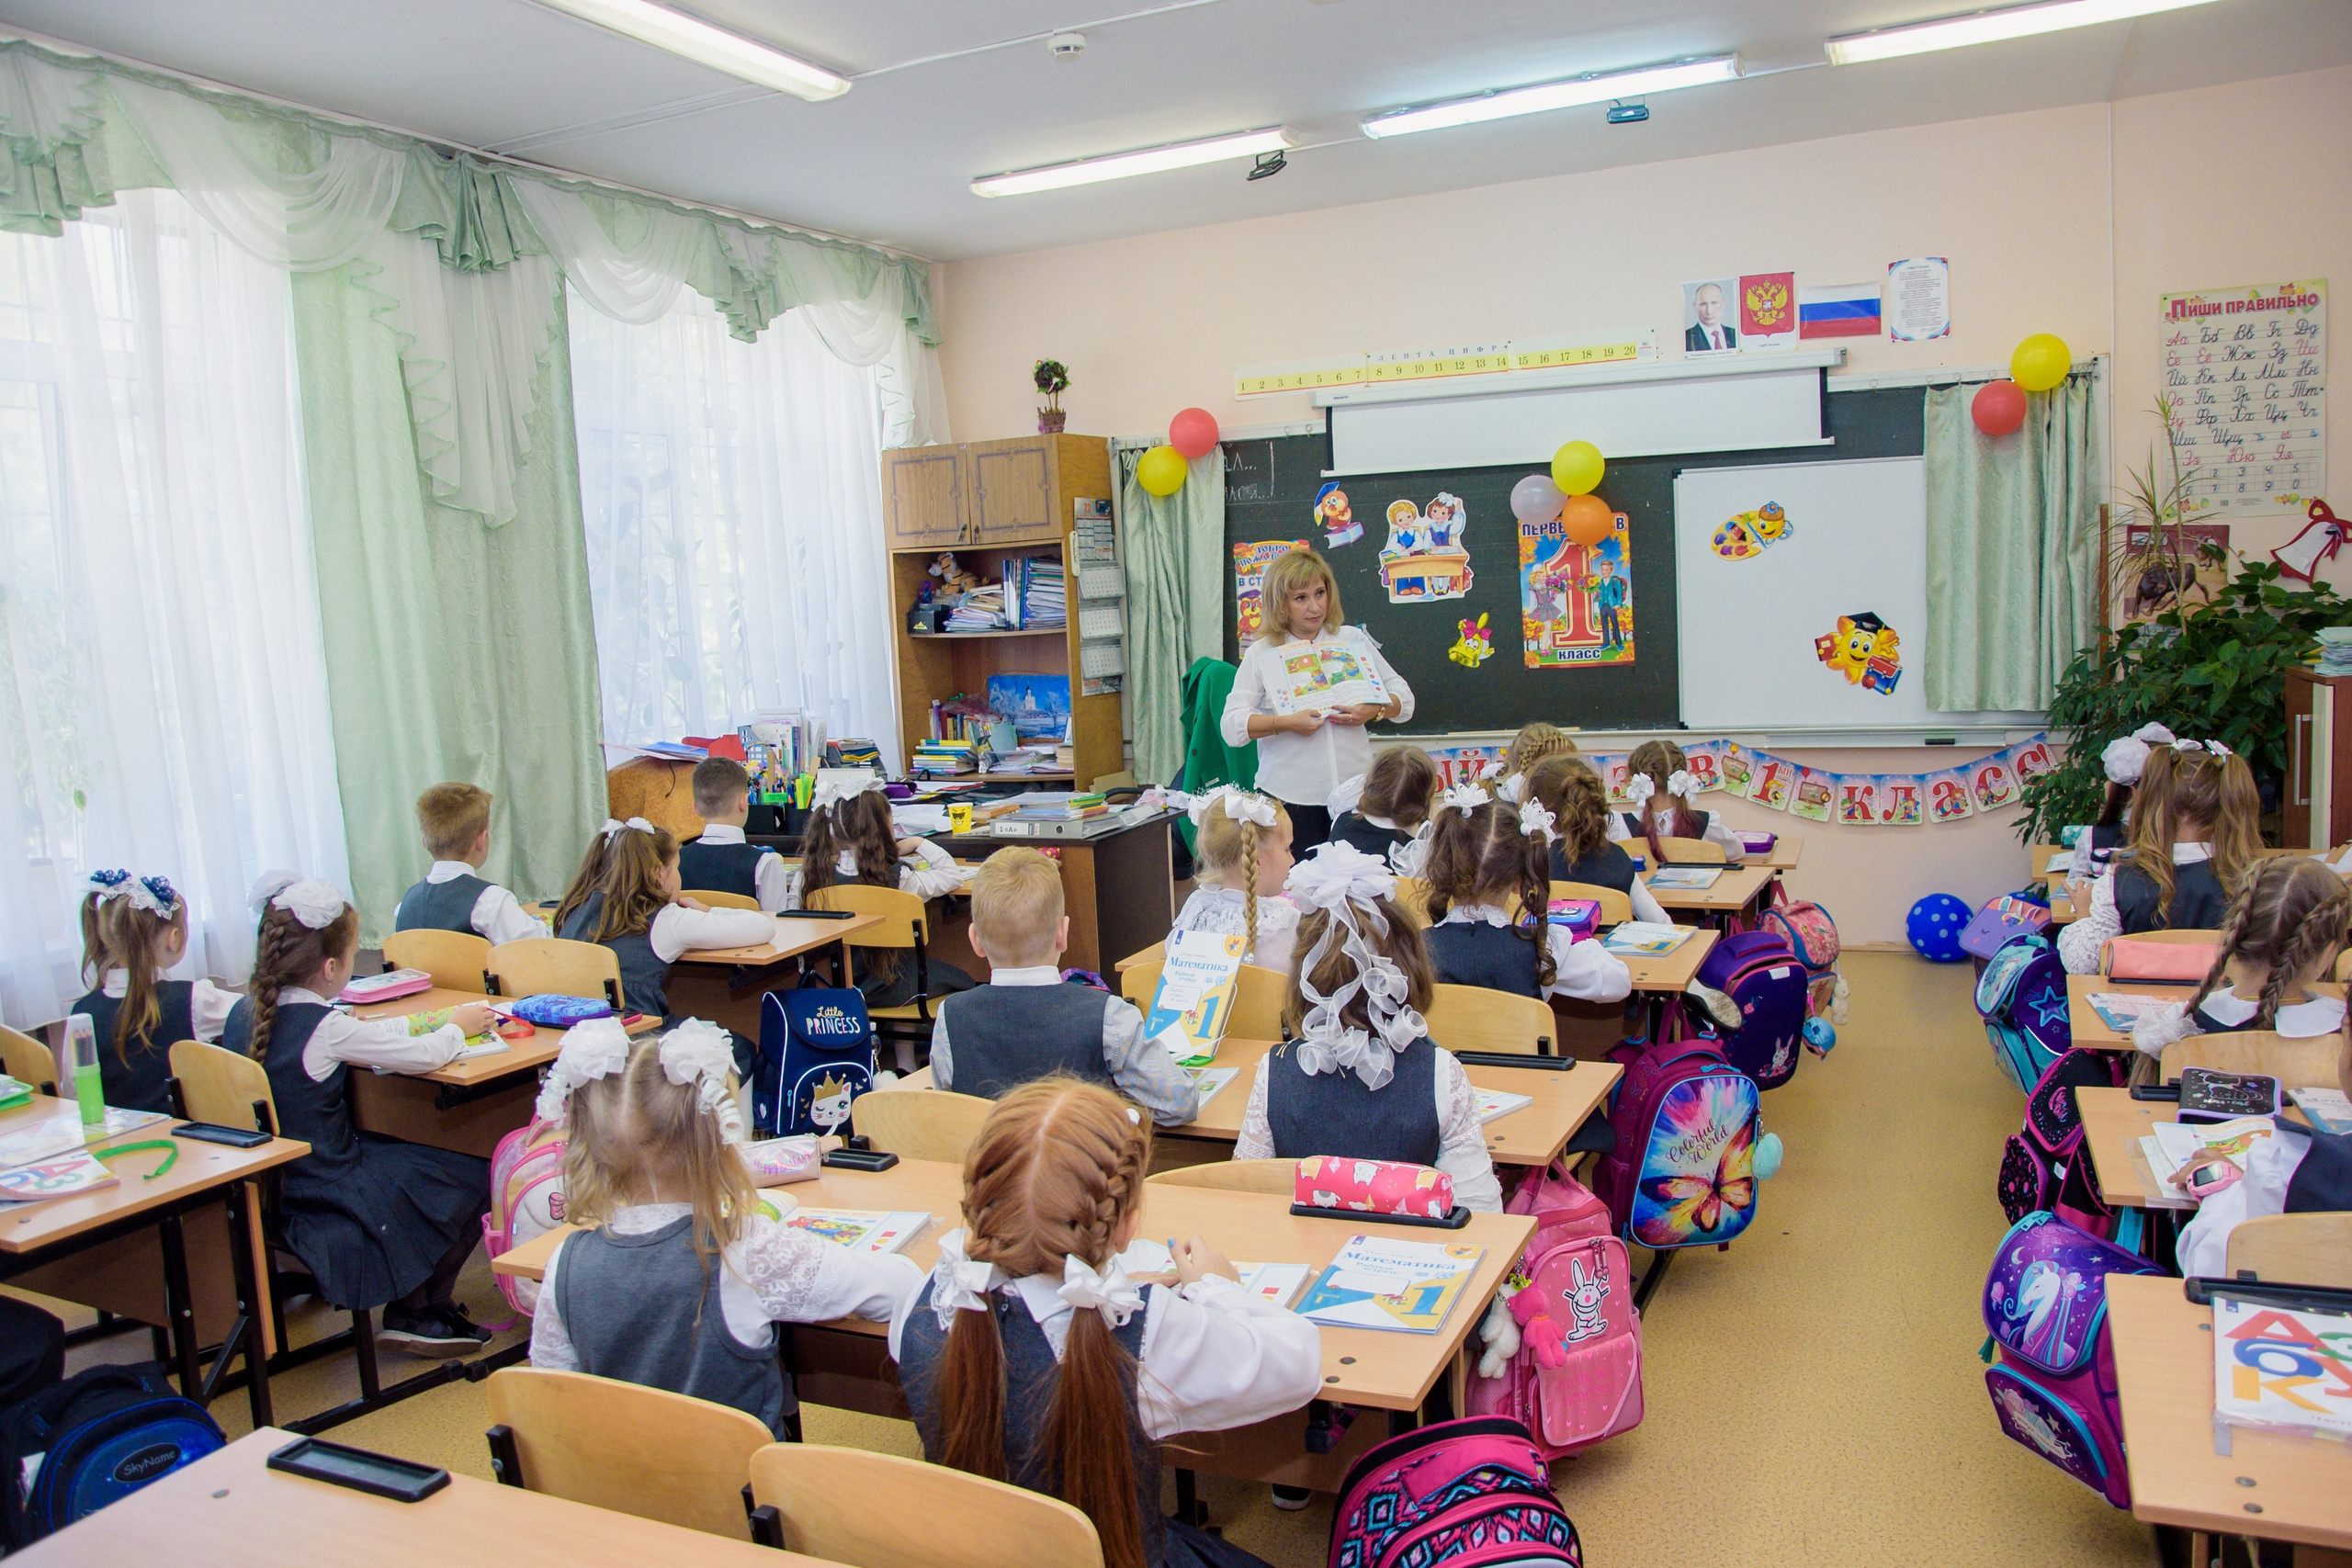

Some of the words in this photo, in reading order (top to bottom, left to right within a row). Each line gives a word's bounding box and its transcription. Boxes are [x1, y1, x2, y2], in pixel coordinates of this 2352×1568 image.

[1259, 380, 1265, 389] 2
[1277, 378, 1283, 387] 3
[1296, 378, 1303, 386] 4
[1317, 375, 1322, 383] 5
[1336, 373, 1342, 381] 6
[1355, 371, 1361, 379] 7
[1376, 368, 1383, 377] 8
[1396, 367, 1402, 375] 9
[1415, 365, 1424, 374] 10
[1434, 363, 1442, 372] 11
[1455, 361, 1464, 370] 12
[1476, 359, 1486, 368] 13
[1497, 357, 1506, 367] 14
[1519, 356, 1529, 366] 15
[1539, 355, 1550, 364] 16
[1560, 352, 1570, 361] 17
[1582, 350, 1592, 359] 18
[1603, 348, 1613, 357] 19
[1623, 345, 1636, 355] 20
[2212, 468, 2219, 478] 2
[2239, 467, 2245, 477] 3
[2293, 463, 2299, 473] 5
[2211, 484, 2218, 493] 7
[2239, 483, 2245, 492] 8
[2266, 481, 2272, 491] 9
[1616, 517, 1624, 530] В
[1255, 545, 1288, 554] ДОБРО
[1239, 553, 1280, 567] ПОЖАЛО
[1238, 578, 1245, 586] В
[1544, 537, 1611, 649] 1
[1169, 956, 1228, 972] Математика
[816, 1006, 843, 1018] Little
[1193, 996, 1220, 1039] 1
[806, 1016, 861, 1035] PRINCESS
[1666, 1118, 1717, 1162] Colorful
[1688, 1124, 1729, 1164] World
[1344, 1252, 1456, 1269] Математика
[1400, 1286, 1445, 1315] 1
[123, 1450, 176, 1476] SkyName
